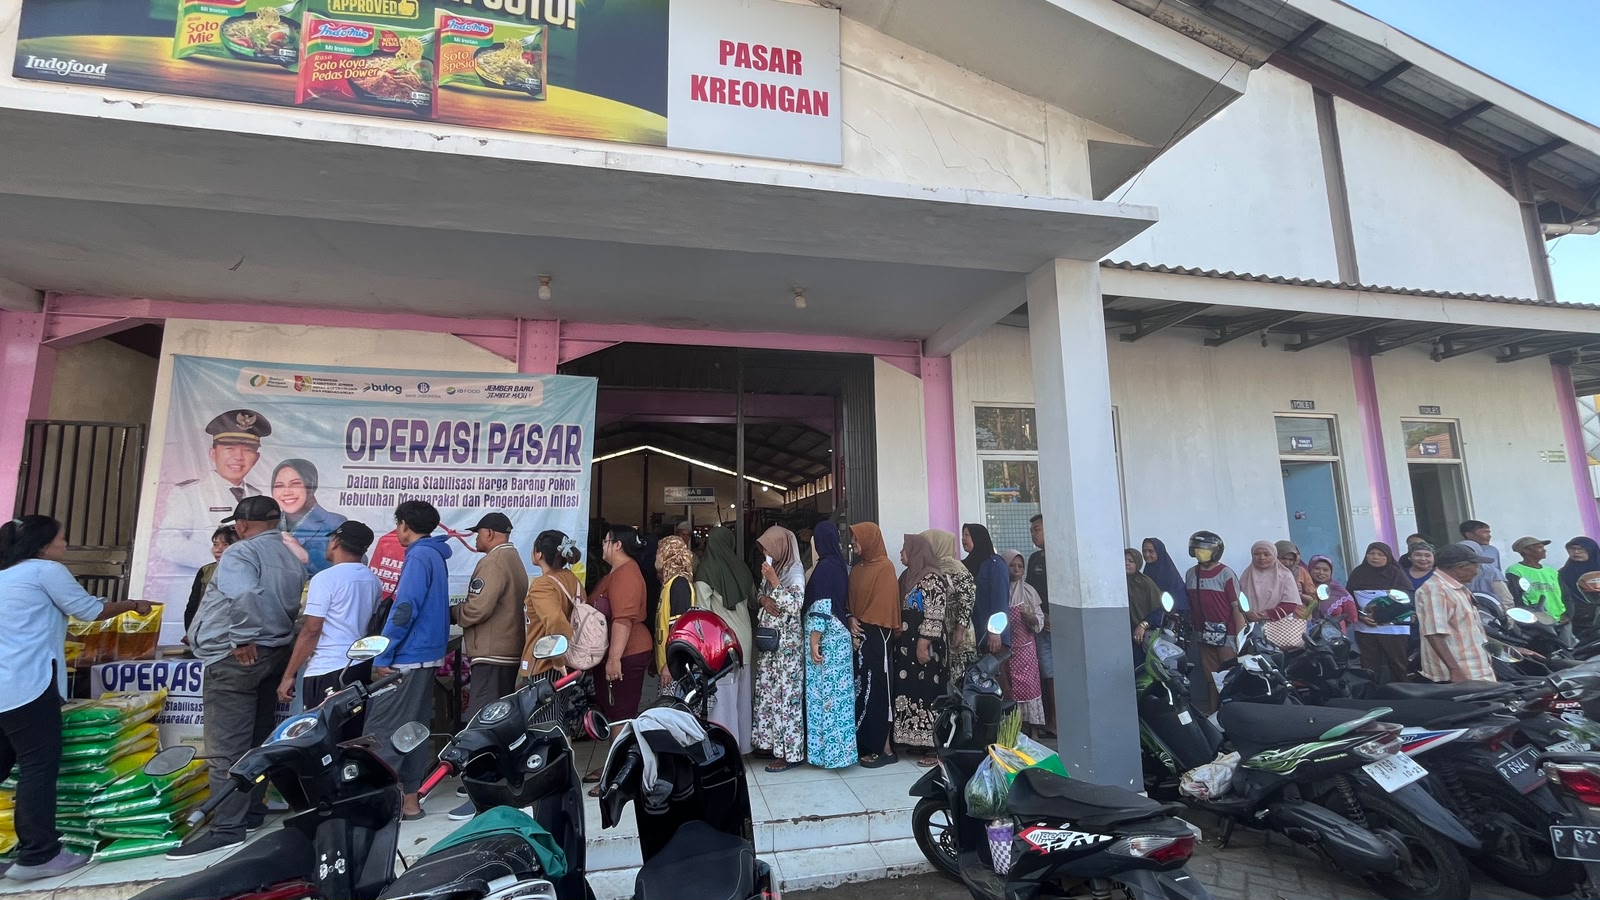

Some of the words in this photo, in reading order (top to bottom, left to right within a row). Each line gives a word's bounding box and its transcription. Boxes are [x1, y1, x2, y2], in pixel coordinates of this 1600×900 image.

[333, 0, 397, 15] APPROVED
[187, 21, 219, 34] Soto
[187, 32, 214, 44] Mie
[334, 45, 355, 53] Instan
[443, 51, 469, 61] Soto
[313, 60, 337, 71] Soto
[339, 59, 366, 70] Koya
[719, 39, 803, 76] PASAR
[25, 55, 108, 76] Indofood
[442, 58, 479, 73] Spesial
[312, 69, 343, 81] Pedas
[344, 68, 380, 79] Dower
[691, 74, 829, 117] KREONGAN
[372, 383, 402, 395] bulog
[1292, 401, 1313, 409] TOILET
[345, 417, 481, 464] OPERASI
[486, 422, 582, 466] PASAR
[347, 474, 379, 489] Dalam
[382, 475, 420, 490] Rangka
[422, 475, 475, 490] Stabilisasi
[478, 477, 508, 491] Harga
[511, 477, 545, 492] Barang
[548, 477, 576, 491] Pokok
[339, 491, 394, 507] Kebutuhan
[463, 494, 480, 507] dan
[483, 494, 548, 508] Pengendalian
[550, 494, 579, 507] Inflasi
[1499, 767, 1510, 779] P
[1507, 756, 1530, 774] 6944
[1553, 829, 1564, 842] P
[1573, 829, 1600, 845] 62
